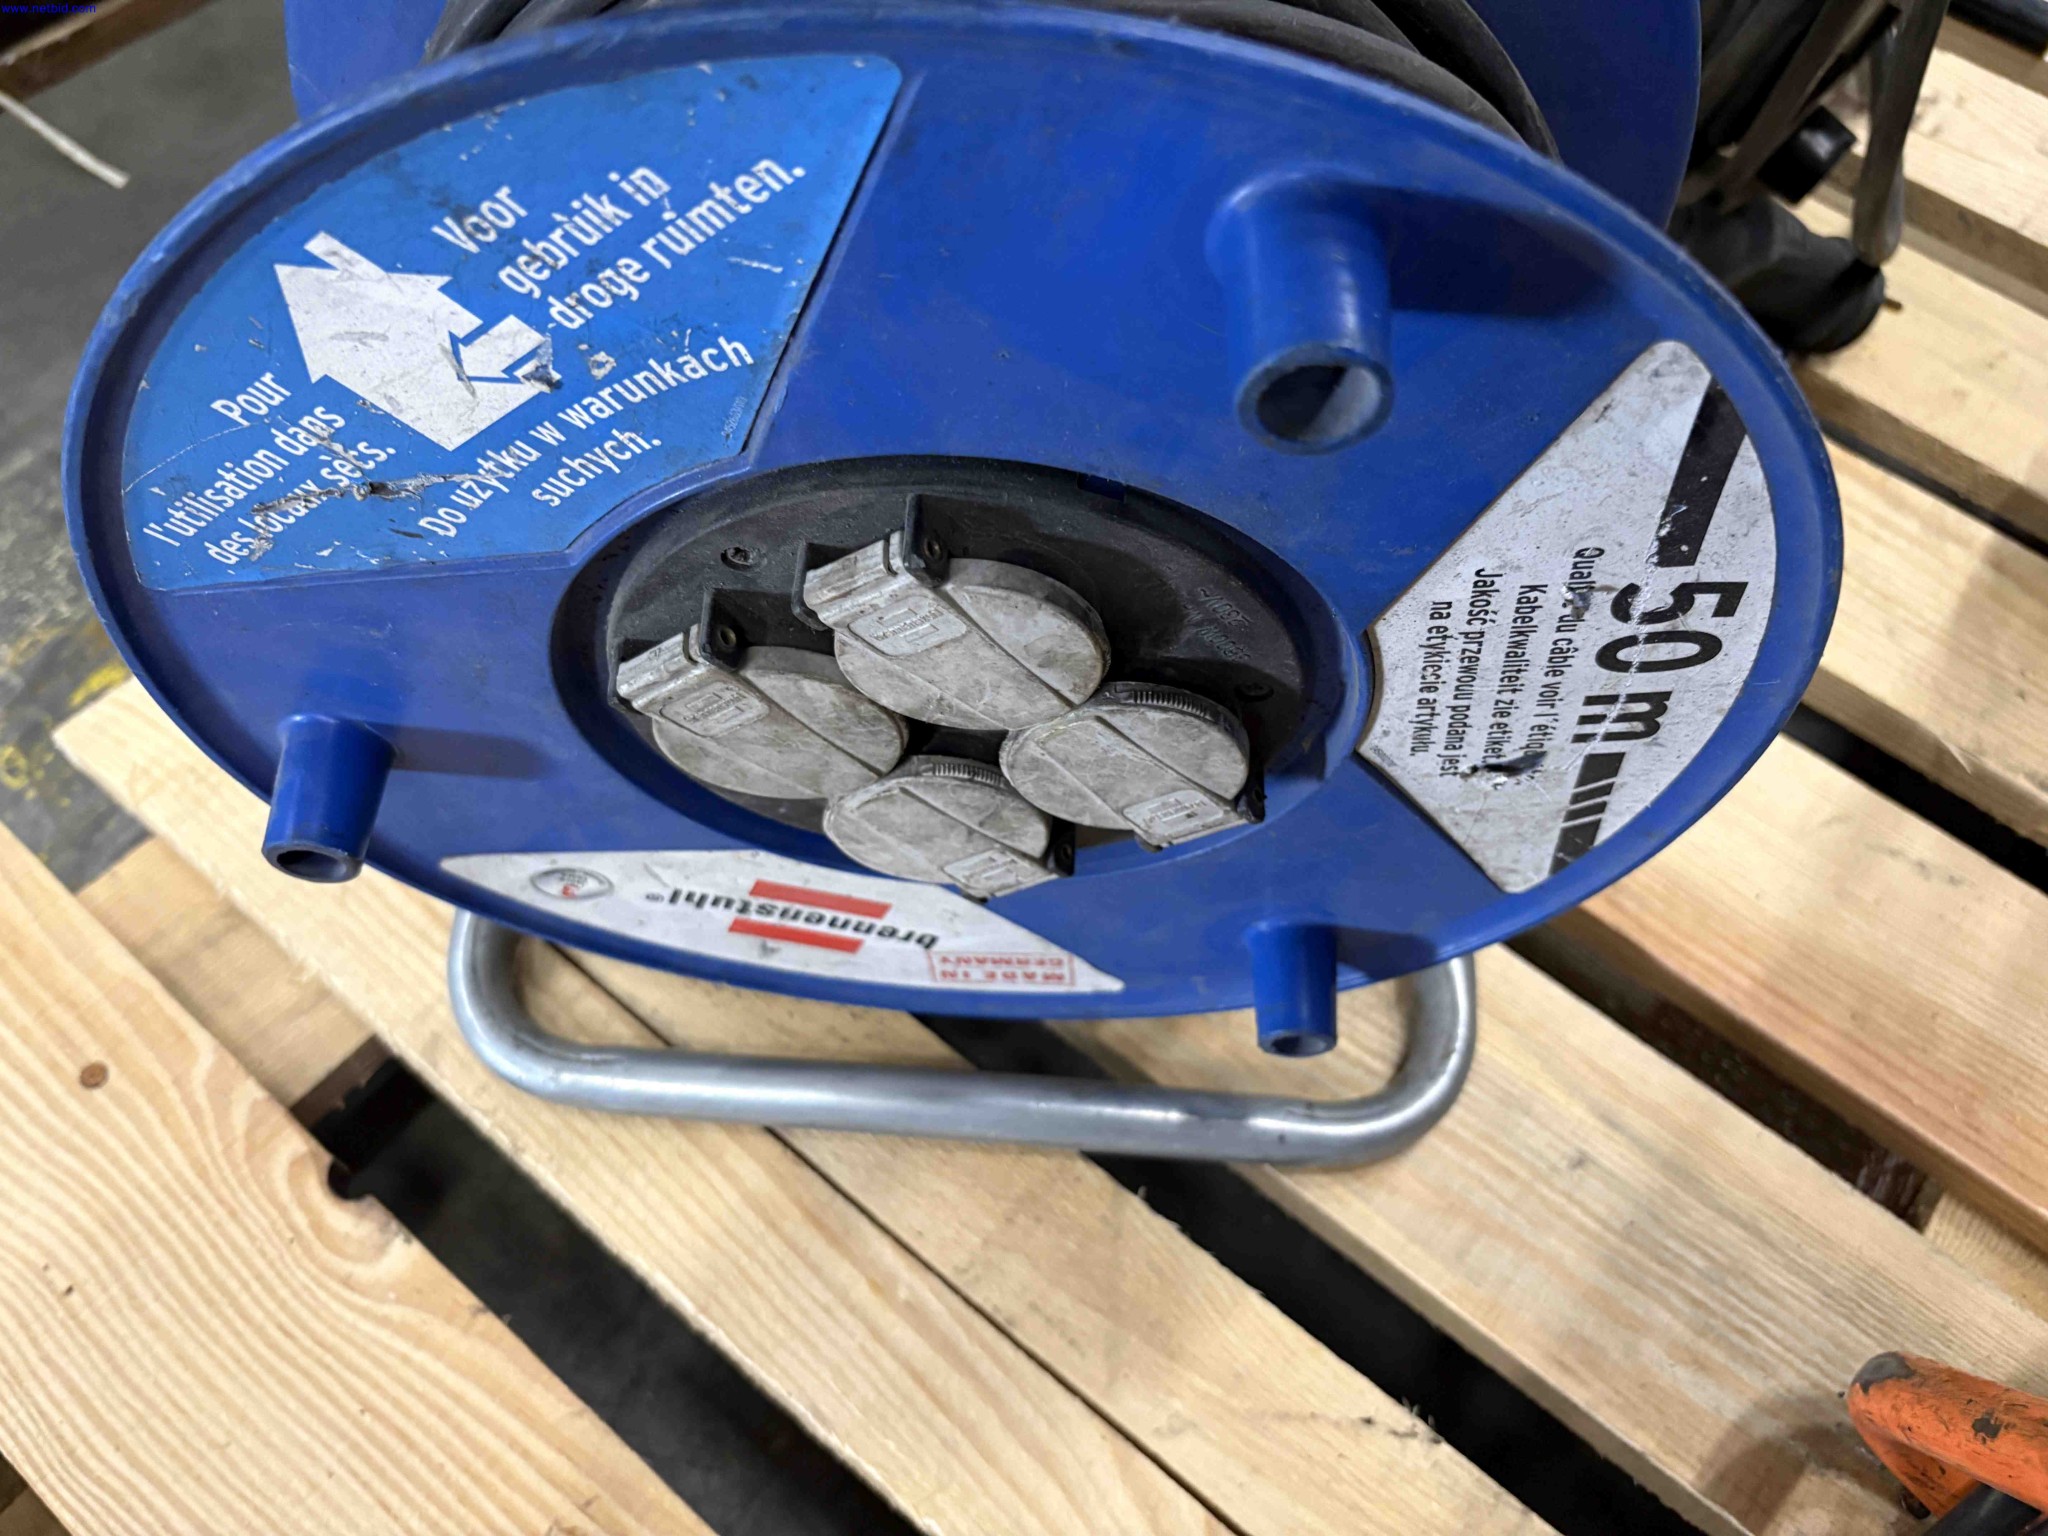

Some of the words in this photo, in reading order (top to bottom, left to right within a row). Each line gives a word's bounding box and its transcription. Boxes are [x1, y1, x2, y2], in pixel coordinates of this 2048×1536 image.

[432, 185, 528, 254] Voor
[499, 192, 632, 299] gebruik
[608, 166, 671, 206] in
[547, 256, 651, 330] droge
[640, 158, 806, 269] ruimten.
[210, 371, 292, 426] Pour
[417, 506, 468, 538] Do
[528, 420, 567, 448] w
[556, 335, 755, 430] warunkach
[142, 447, 290, 547] l'utilisation
[270, 405, 346, 456] dans
[531, 428, 662, 508] suchych.
[203, 530, 256, 566] des
[1429, 601, 1453, 621] na
[1466, 567, 1504, 626] Jakość
[1555, 614, 1586, 633] du
[1496, 584, 1549, 695] Kabelkwaliteit
[1596, 581, 1748, 674] 50
[1418, 625, 1455, 694] etykiecie
[1543, 637, 1580, 678] câble
[1491, 698, 1520, 719] zie
[1535, 681, 1564, 709] voir
[1570, 690, 1674, 744] m
[1445, 704, 1474, 751] podana
[1481, 722, 1513, 764] etiket.
[1437, 753, 1468, 777] jest
[667, 887, 940, 950] brennenstuhl
[940, 955, 1064, 967] GERMANY
[985, 970, 1065, 981] MADE
